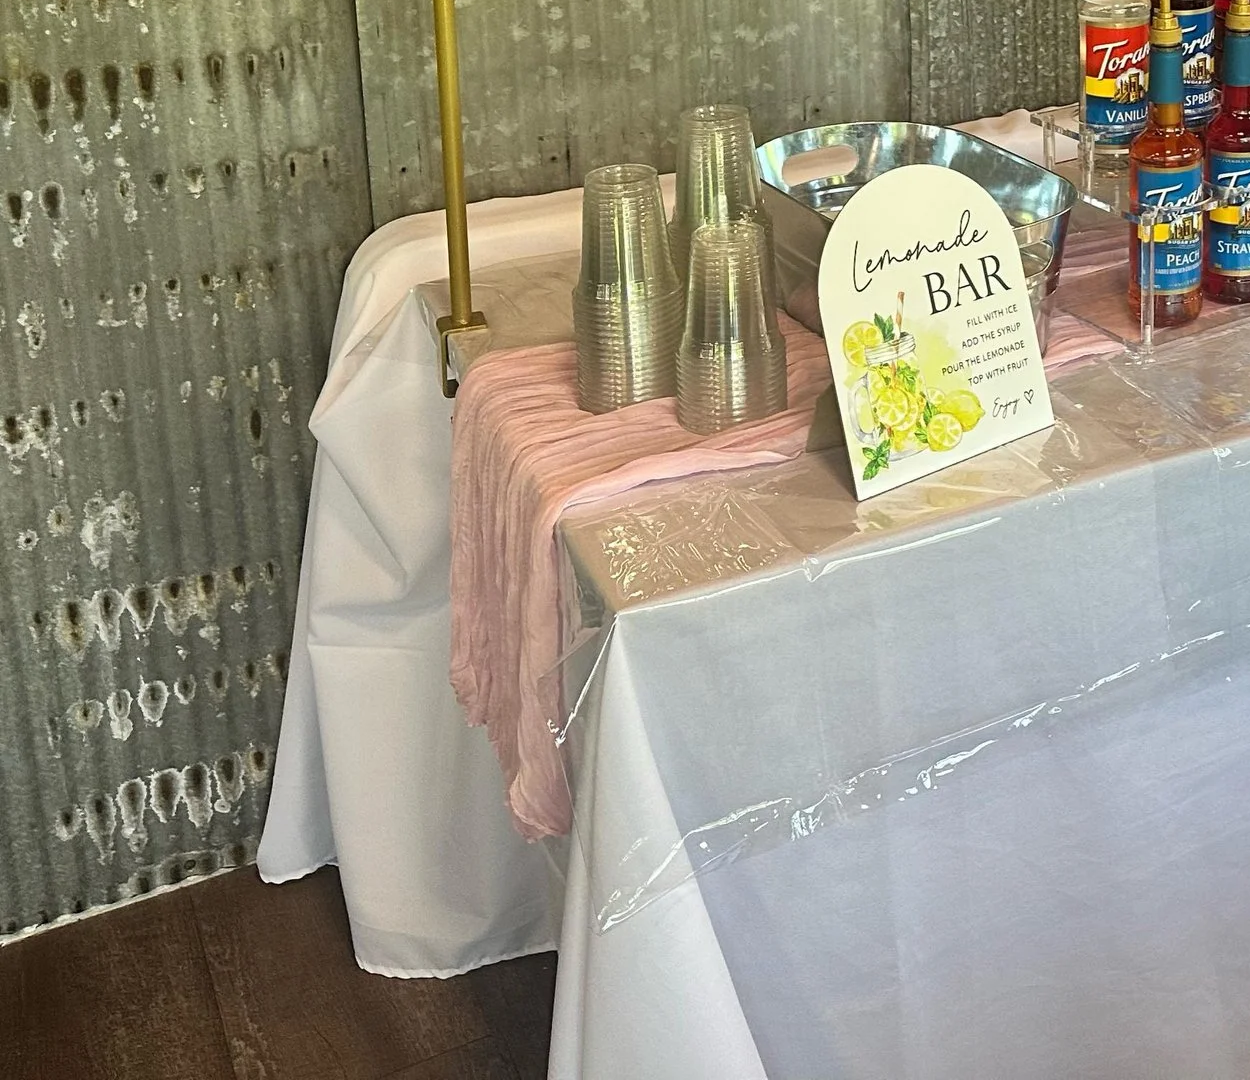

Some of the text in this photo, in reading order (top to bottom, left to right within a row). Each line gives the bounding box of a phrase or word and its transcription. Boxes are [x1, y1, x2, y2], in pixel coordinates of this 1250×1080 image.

[1092, 39, 1150, 81] Toran
[853, 209, 989, 293] Lemonade
[1166, 249, 1200, 267] PEACH
[922, 254, 1012, 315] BAR
[966, 303, 1018, 328] FILL WITH ICE
[961, 321, 1021, 349] ADD THE SYRUP
[941, 339, 1025, 376] POUR THE LEMONADE
[967, 357, 1029, 386] TOP WITH FRUIT
[992, 397, 1020, 419] Enjoy
